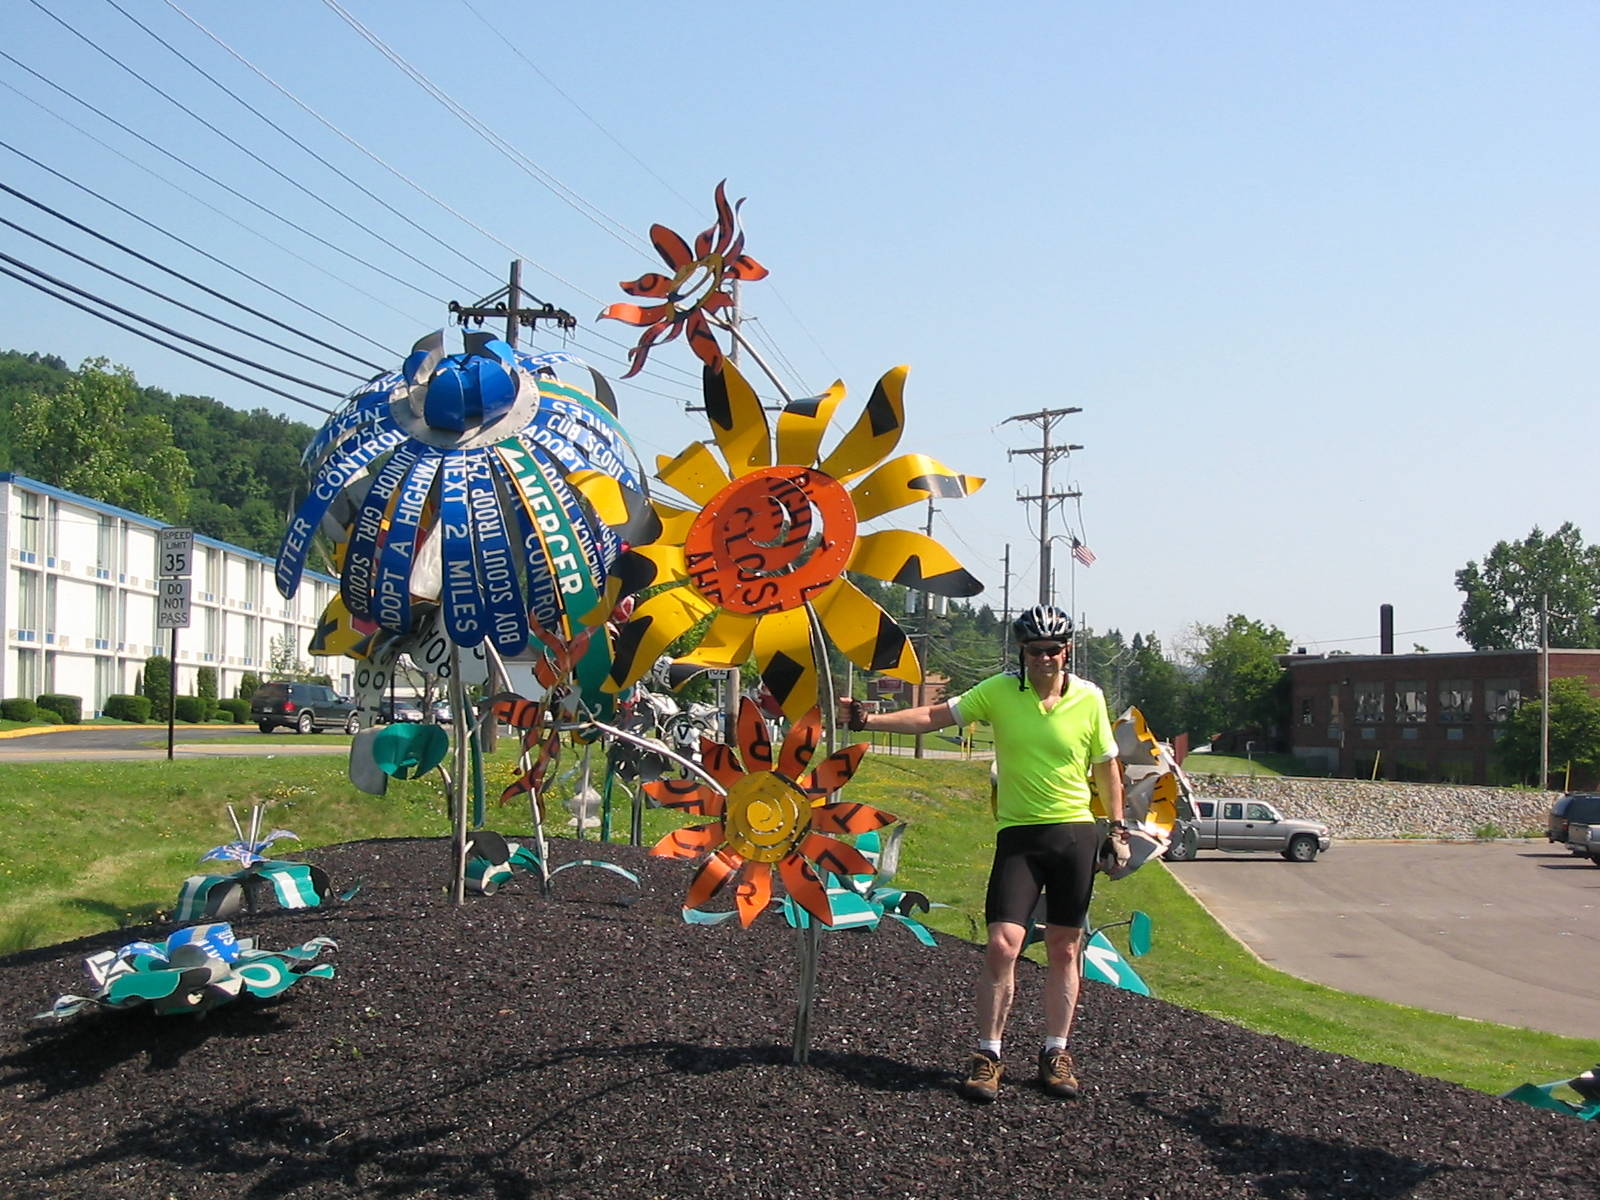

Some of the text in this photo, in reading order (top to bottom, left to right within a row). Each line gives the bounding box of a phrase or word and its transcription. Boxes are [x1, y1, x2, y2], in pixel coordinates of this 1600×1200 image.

[521, 425, 585, 472] ADOPT
[547, 414, 625, 482] CUB SCOUT
[164, 531, 191, 540] SPEED
[278, 517, 312, 597] LITTER
[316, 429, 410, 500] CONTROL
[349, 445, 417, 614] JUNIOR GIRL SCOUTS
[471, 488, 501, 542] TROOP
[518, 475, 583, 596] MERCER
[165, 553, 185, 571] 35
[166, 542, 187, 550] LIMIT
[380, 446, 444, 634] ADOPT A HIGHWAY
[443, 455, 478, 633] NEXT 2 MILES
[168, 584, 182, 595] DO
[483, 549, 514, 604] SCOUT
[161, 612, 188, 624] PASS
[164, 598, 184, 609] NOT
[494, 611, 521, 644] BOY
